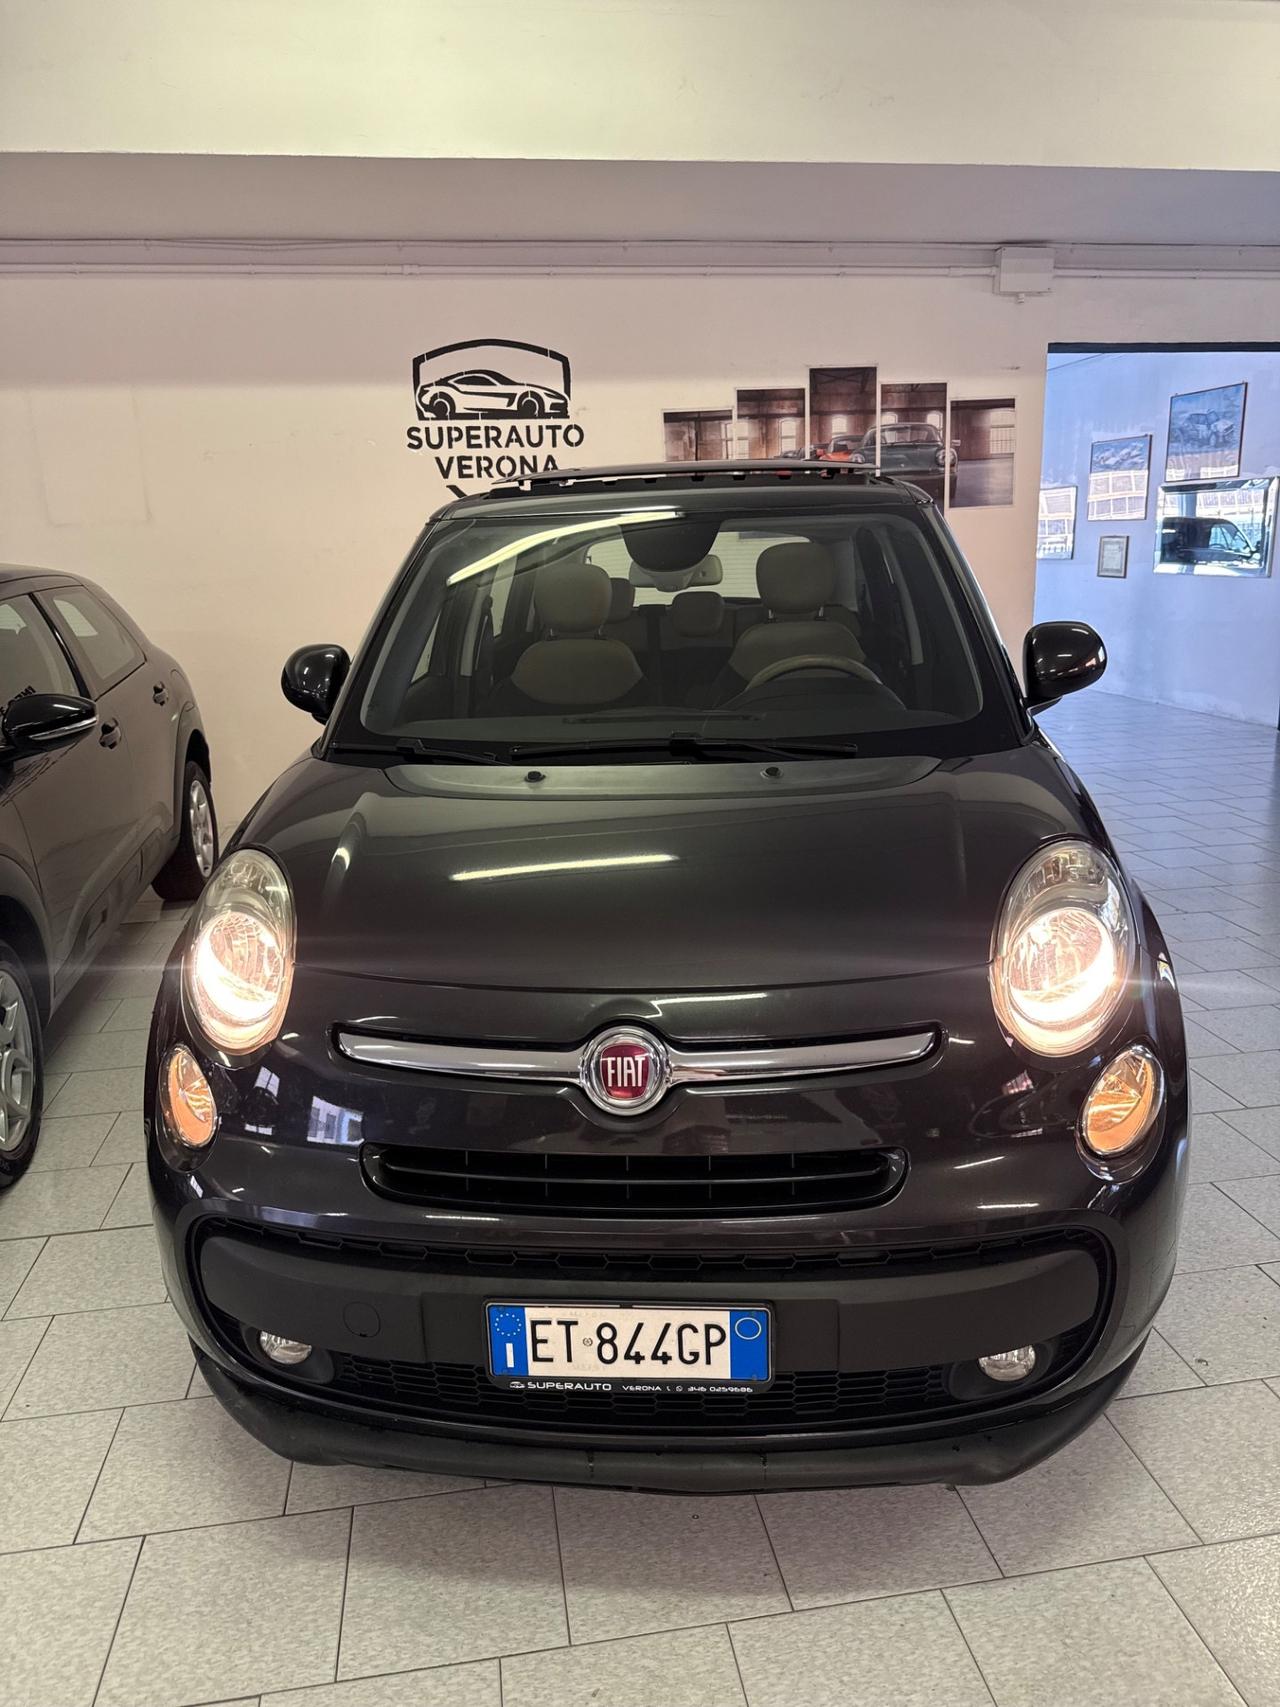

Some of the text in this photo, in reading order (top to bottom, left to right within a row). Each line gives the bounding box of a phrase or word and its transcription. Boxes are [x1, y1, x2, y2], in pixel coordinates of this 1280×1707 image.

[406, 424, 585, 450] SUPERAUTO
[435, 454, 560, 479] VERONA
[606, 1056, 646, 1088] FIAT
[530, 1319, 579, 1363] ET
[527, 1381, 612, 1391] SUPERAUTO
